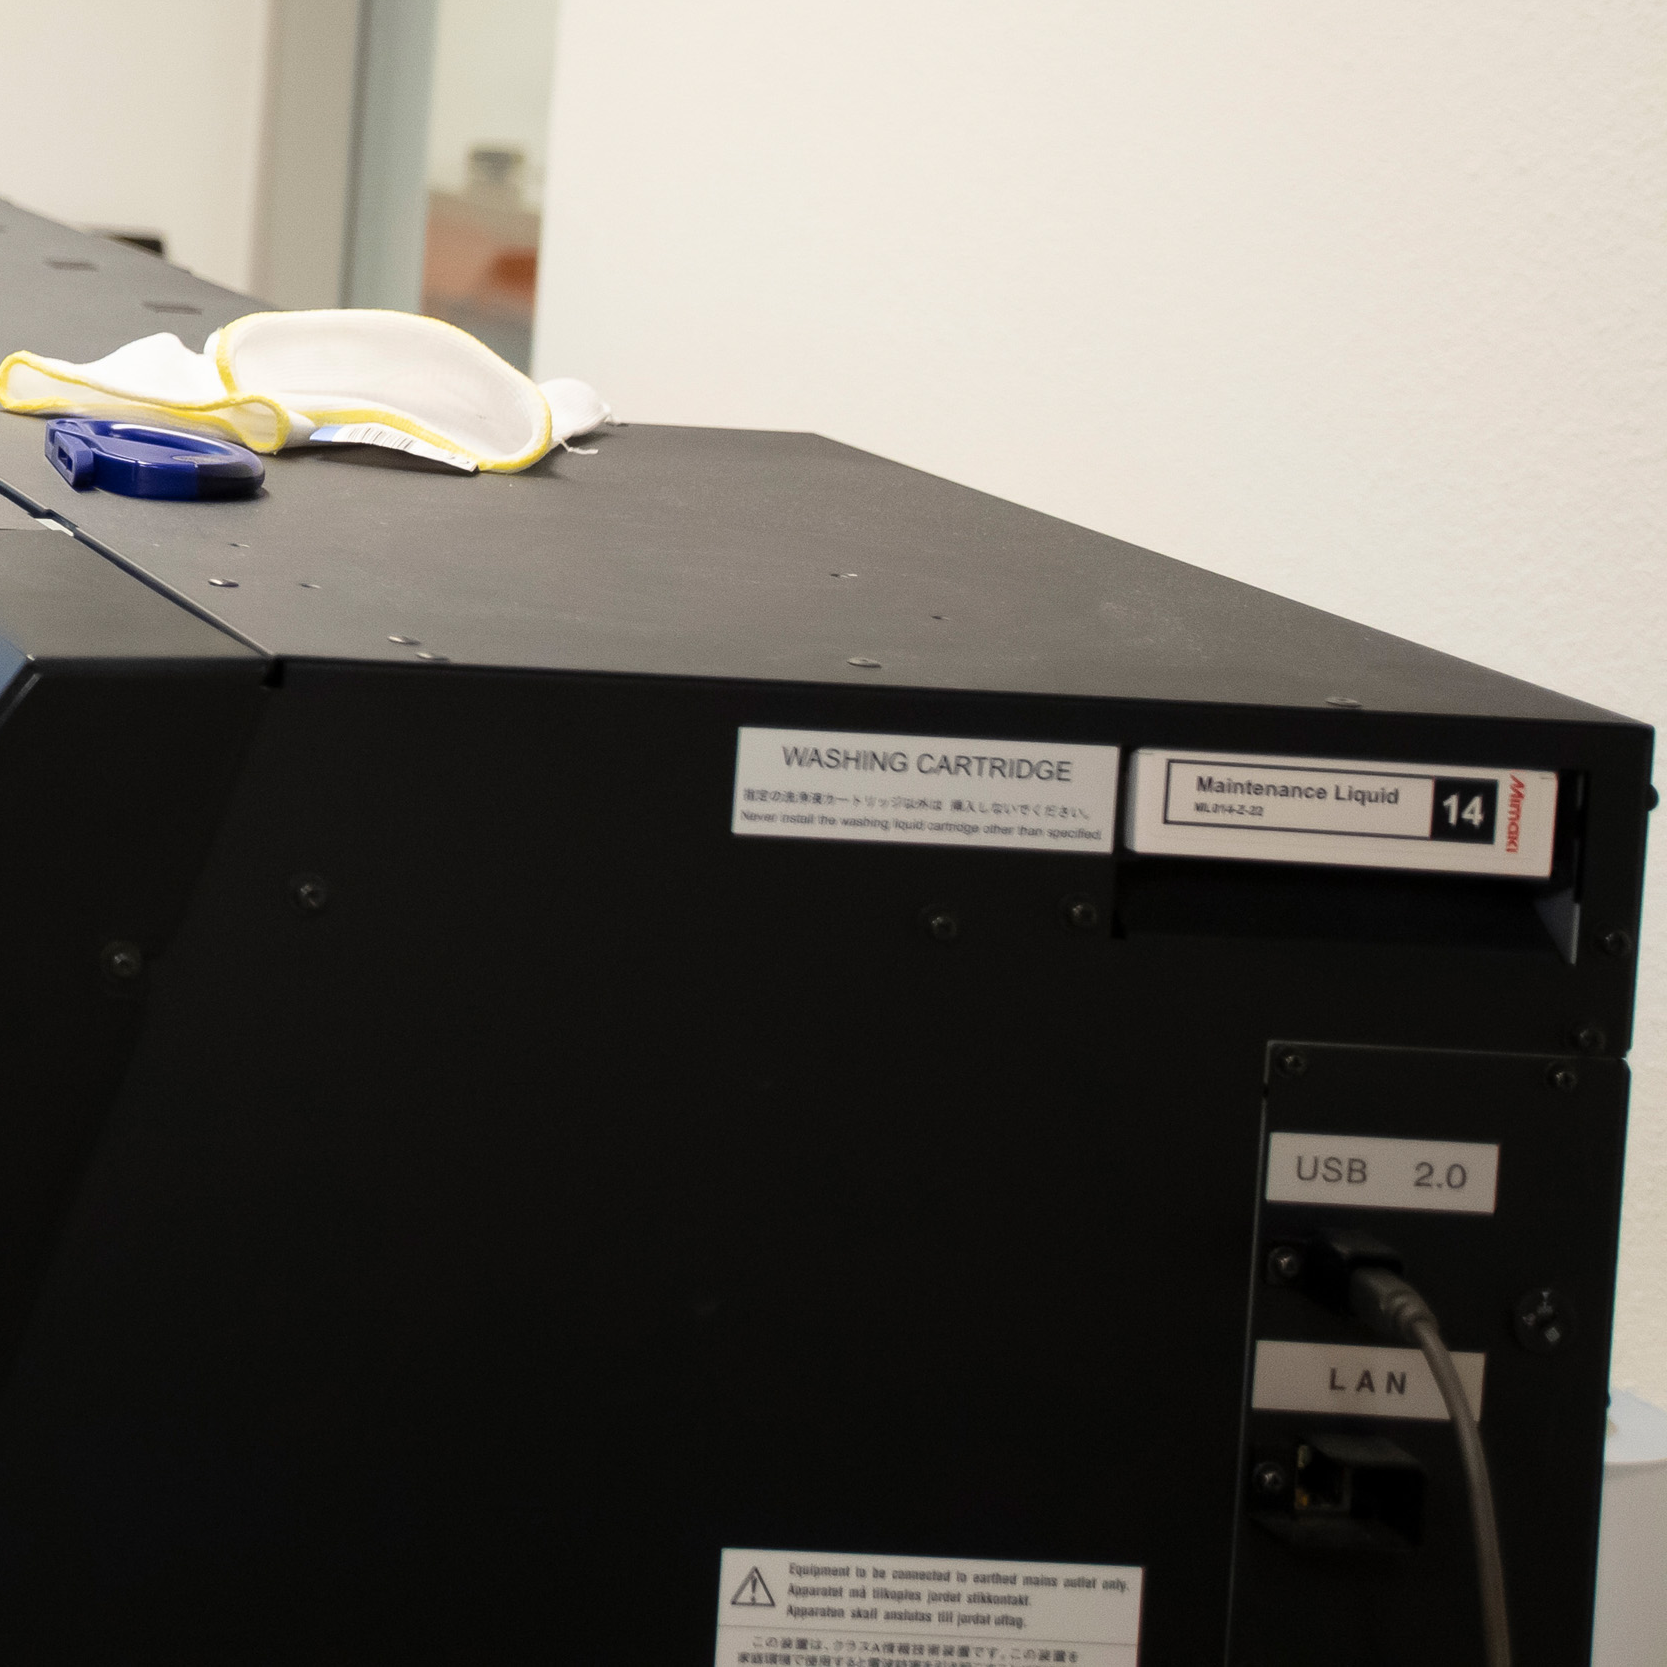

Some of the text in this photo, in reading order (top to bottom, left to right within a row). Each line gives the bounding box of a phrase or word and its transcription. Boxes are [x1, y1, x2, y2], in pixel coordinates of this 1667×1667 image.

[782, 744, 1073, 782] WASHING CARTRIDGE
[1196, 775, 1400, 807] Maintenance Liquid
[741, 809, 775, 823] Never
[780, 812, 814, 825] install
[818, 814, 836, 826] the
[840, 815, 890, 831] washing
[893, 817, 925, 832] liquid
[928, 820, 980, 835] cartridge
[983, 823, 1013, 835] other
[1017, 824, 1043, 837] than
[1442, 792, 1484, 829] 14
[1505, 773, 1526, 854] Mimaki
[1295, 1154, 1468, 1190] USB 2.0
[788, 1561, 850, 1579] Equipment
[855, 1565, 867, 1578] to
[872, 1565, 886, 1579] be
[892, 1568, 951, 1583] connected
[956, 1570, 967, 1583] to
[972, 1572, 1017, 1585] earthed
[1022, 1573, 1058, 1588] mains
[1063, 1576, 1097, 1590] outlet
[937, 1610, 954, 1624] till
